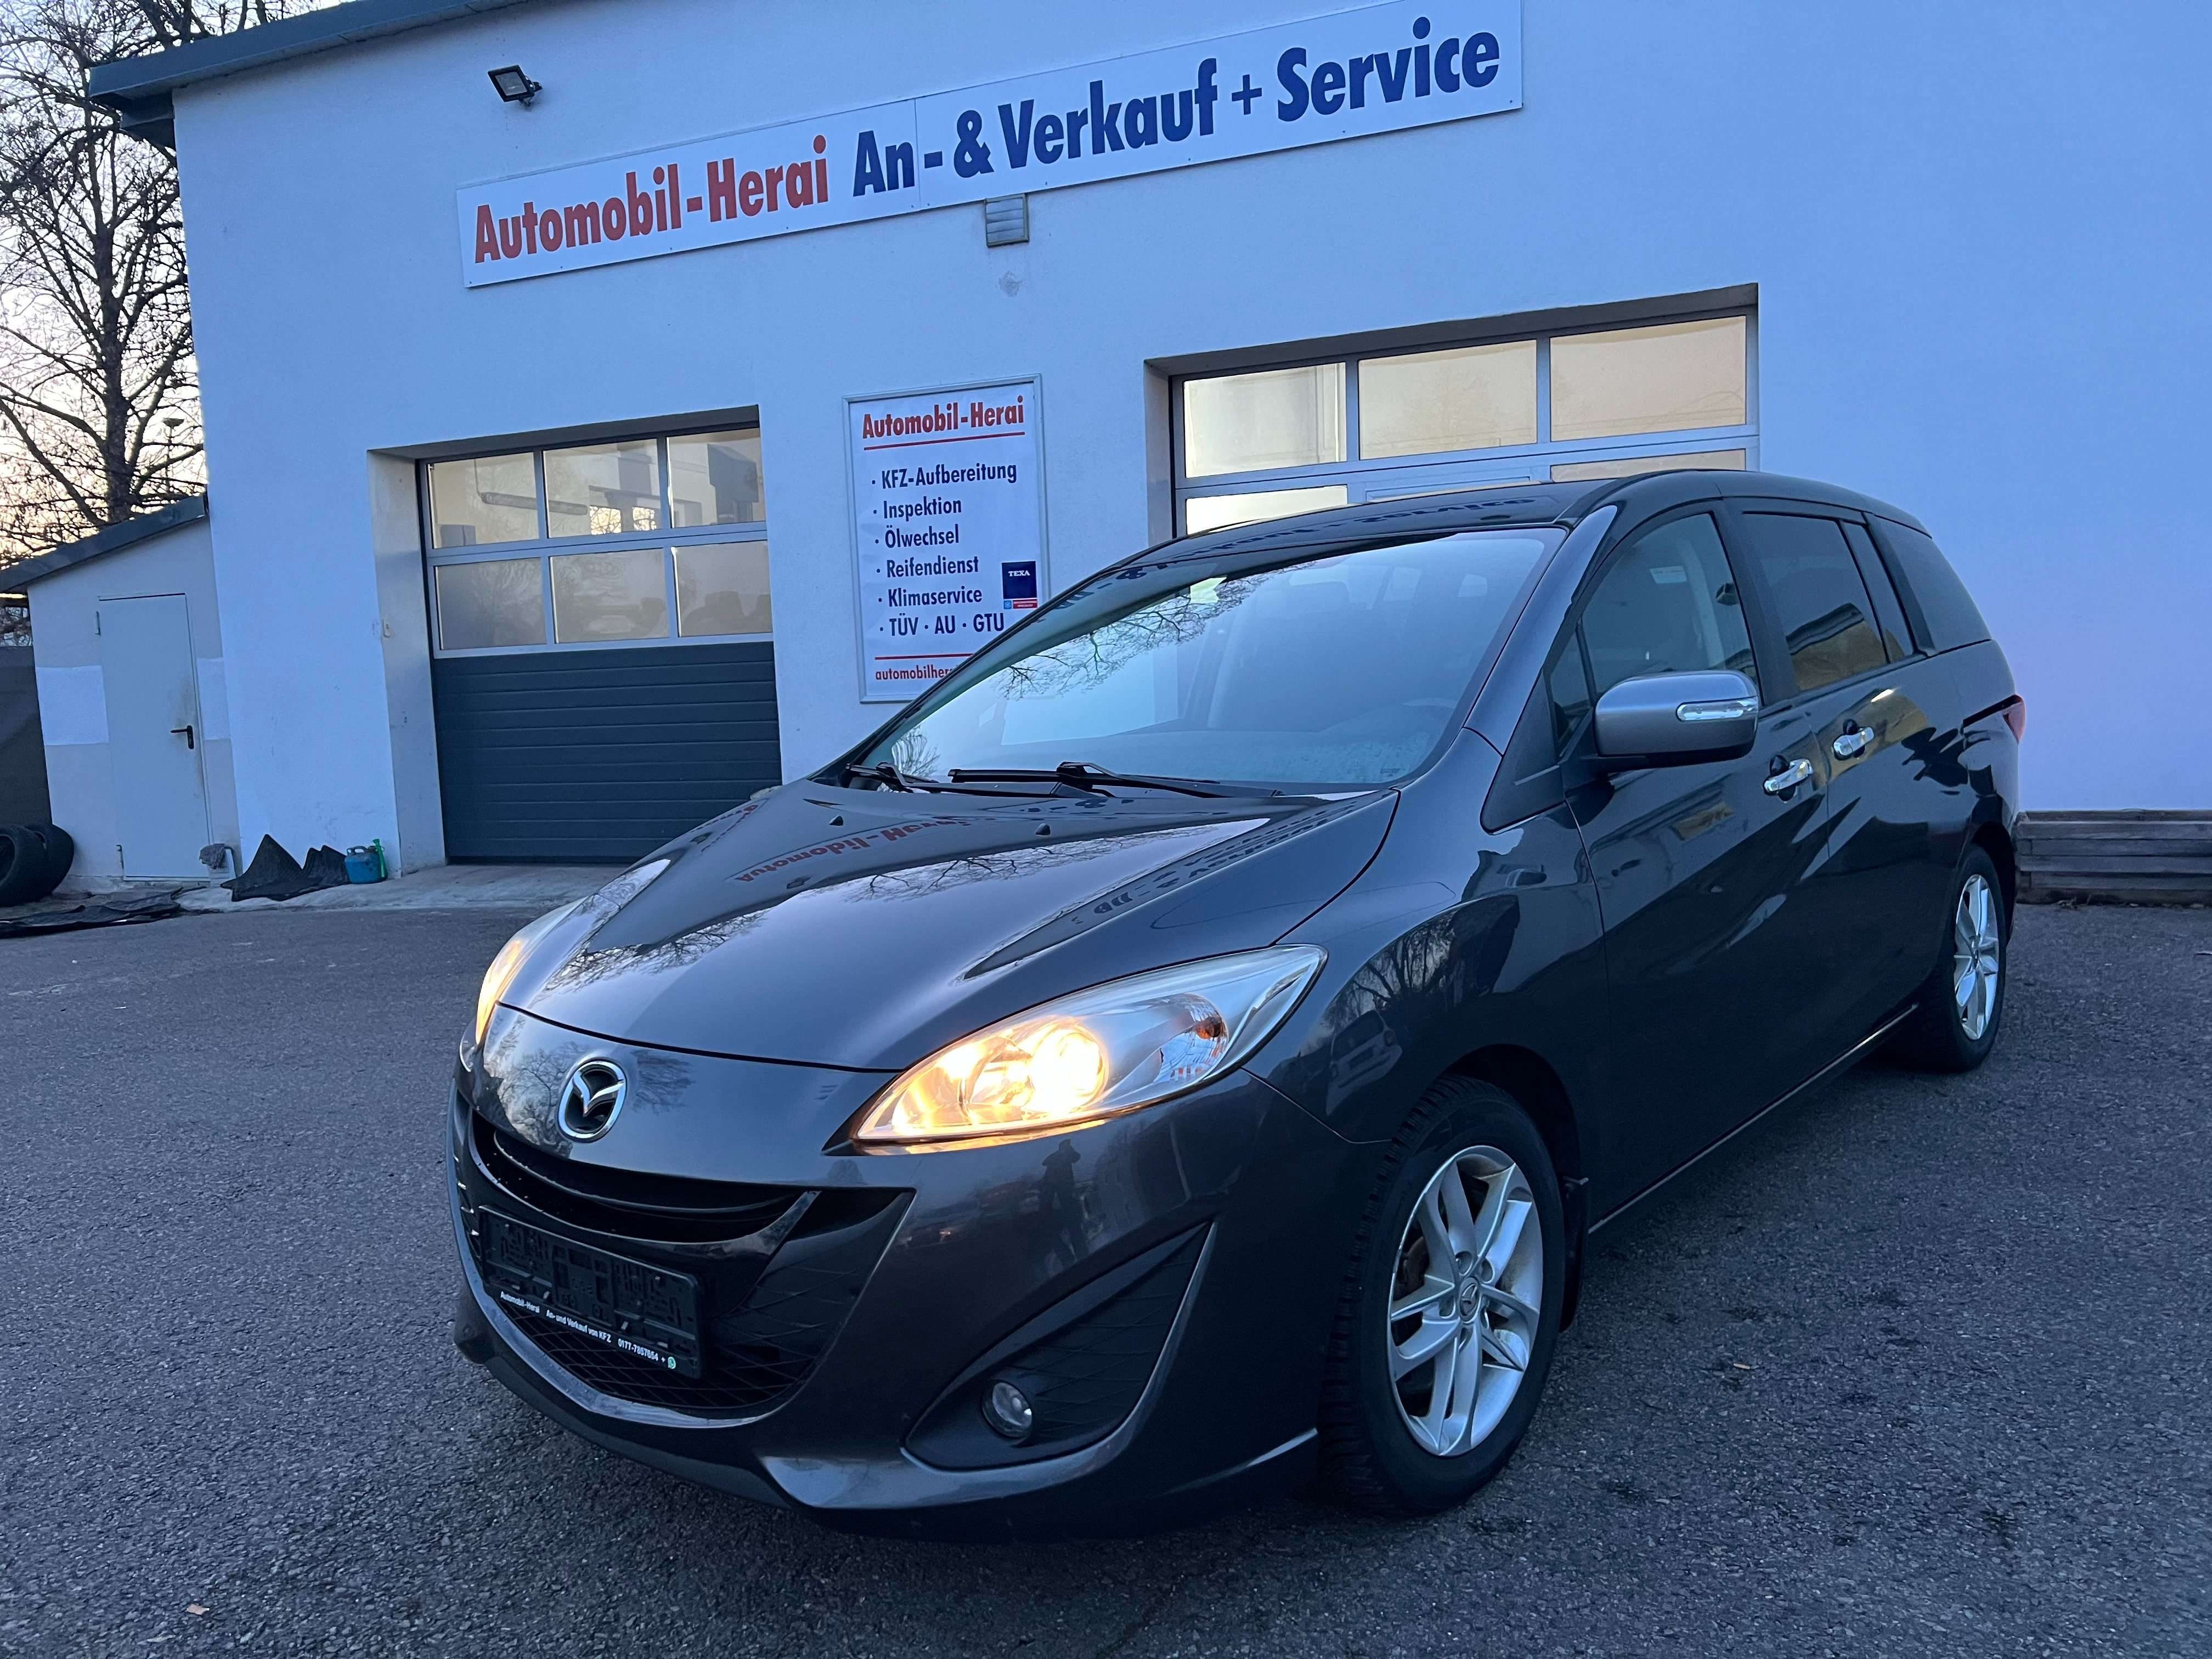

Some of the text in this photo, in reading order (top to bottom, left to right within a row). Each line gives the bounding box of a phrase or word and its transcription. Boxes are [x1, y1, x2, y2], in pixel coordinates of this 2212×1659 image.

[476, 136, 828, 263] Automobil-Herai
[953, 110, 995, 178] &
[998, 58, 1218, 169] Verkauf
[1232, 74, 1262, 115] +
[1277, 16, 1500, 122] Service
[862, 395, 1024, 439] Automobil-Herai
[882, 462, 1017, 489] KFZ-Aufbereitung
[883, 496, 962, 522] Inspektion
[884, 523, 960, 549] Ölwechsel
[887, 555, 979, 578] Reifendienst
[888, 585, 983, 607] Klimaservice
[889, 612, 1005, 636] TÜV AU GTU
[876, 664, 955, 680] automobilher
